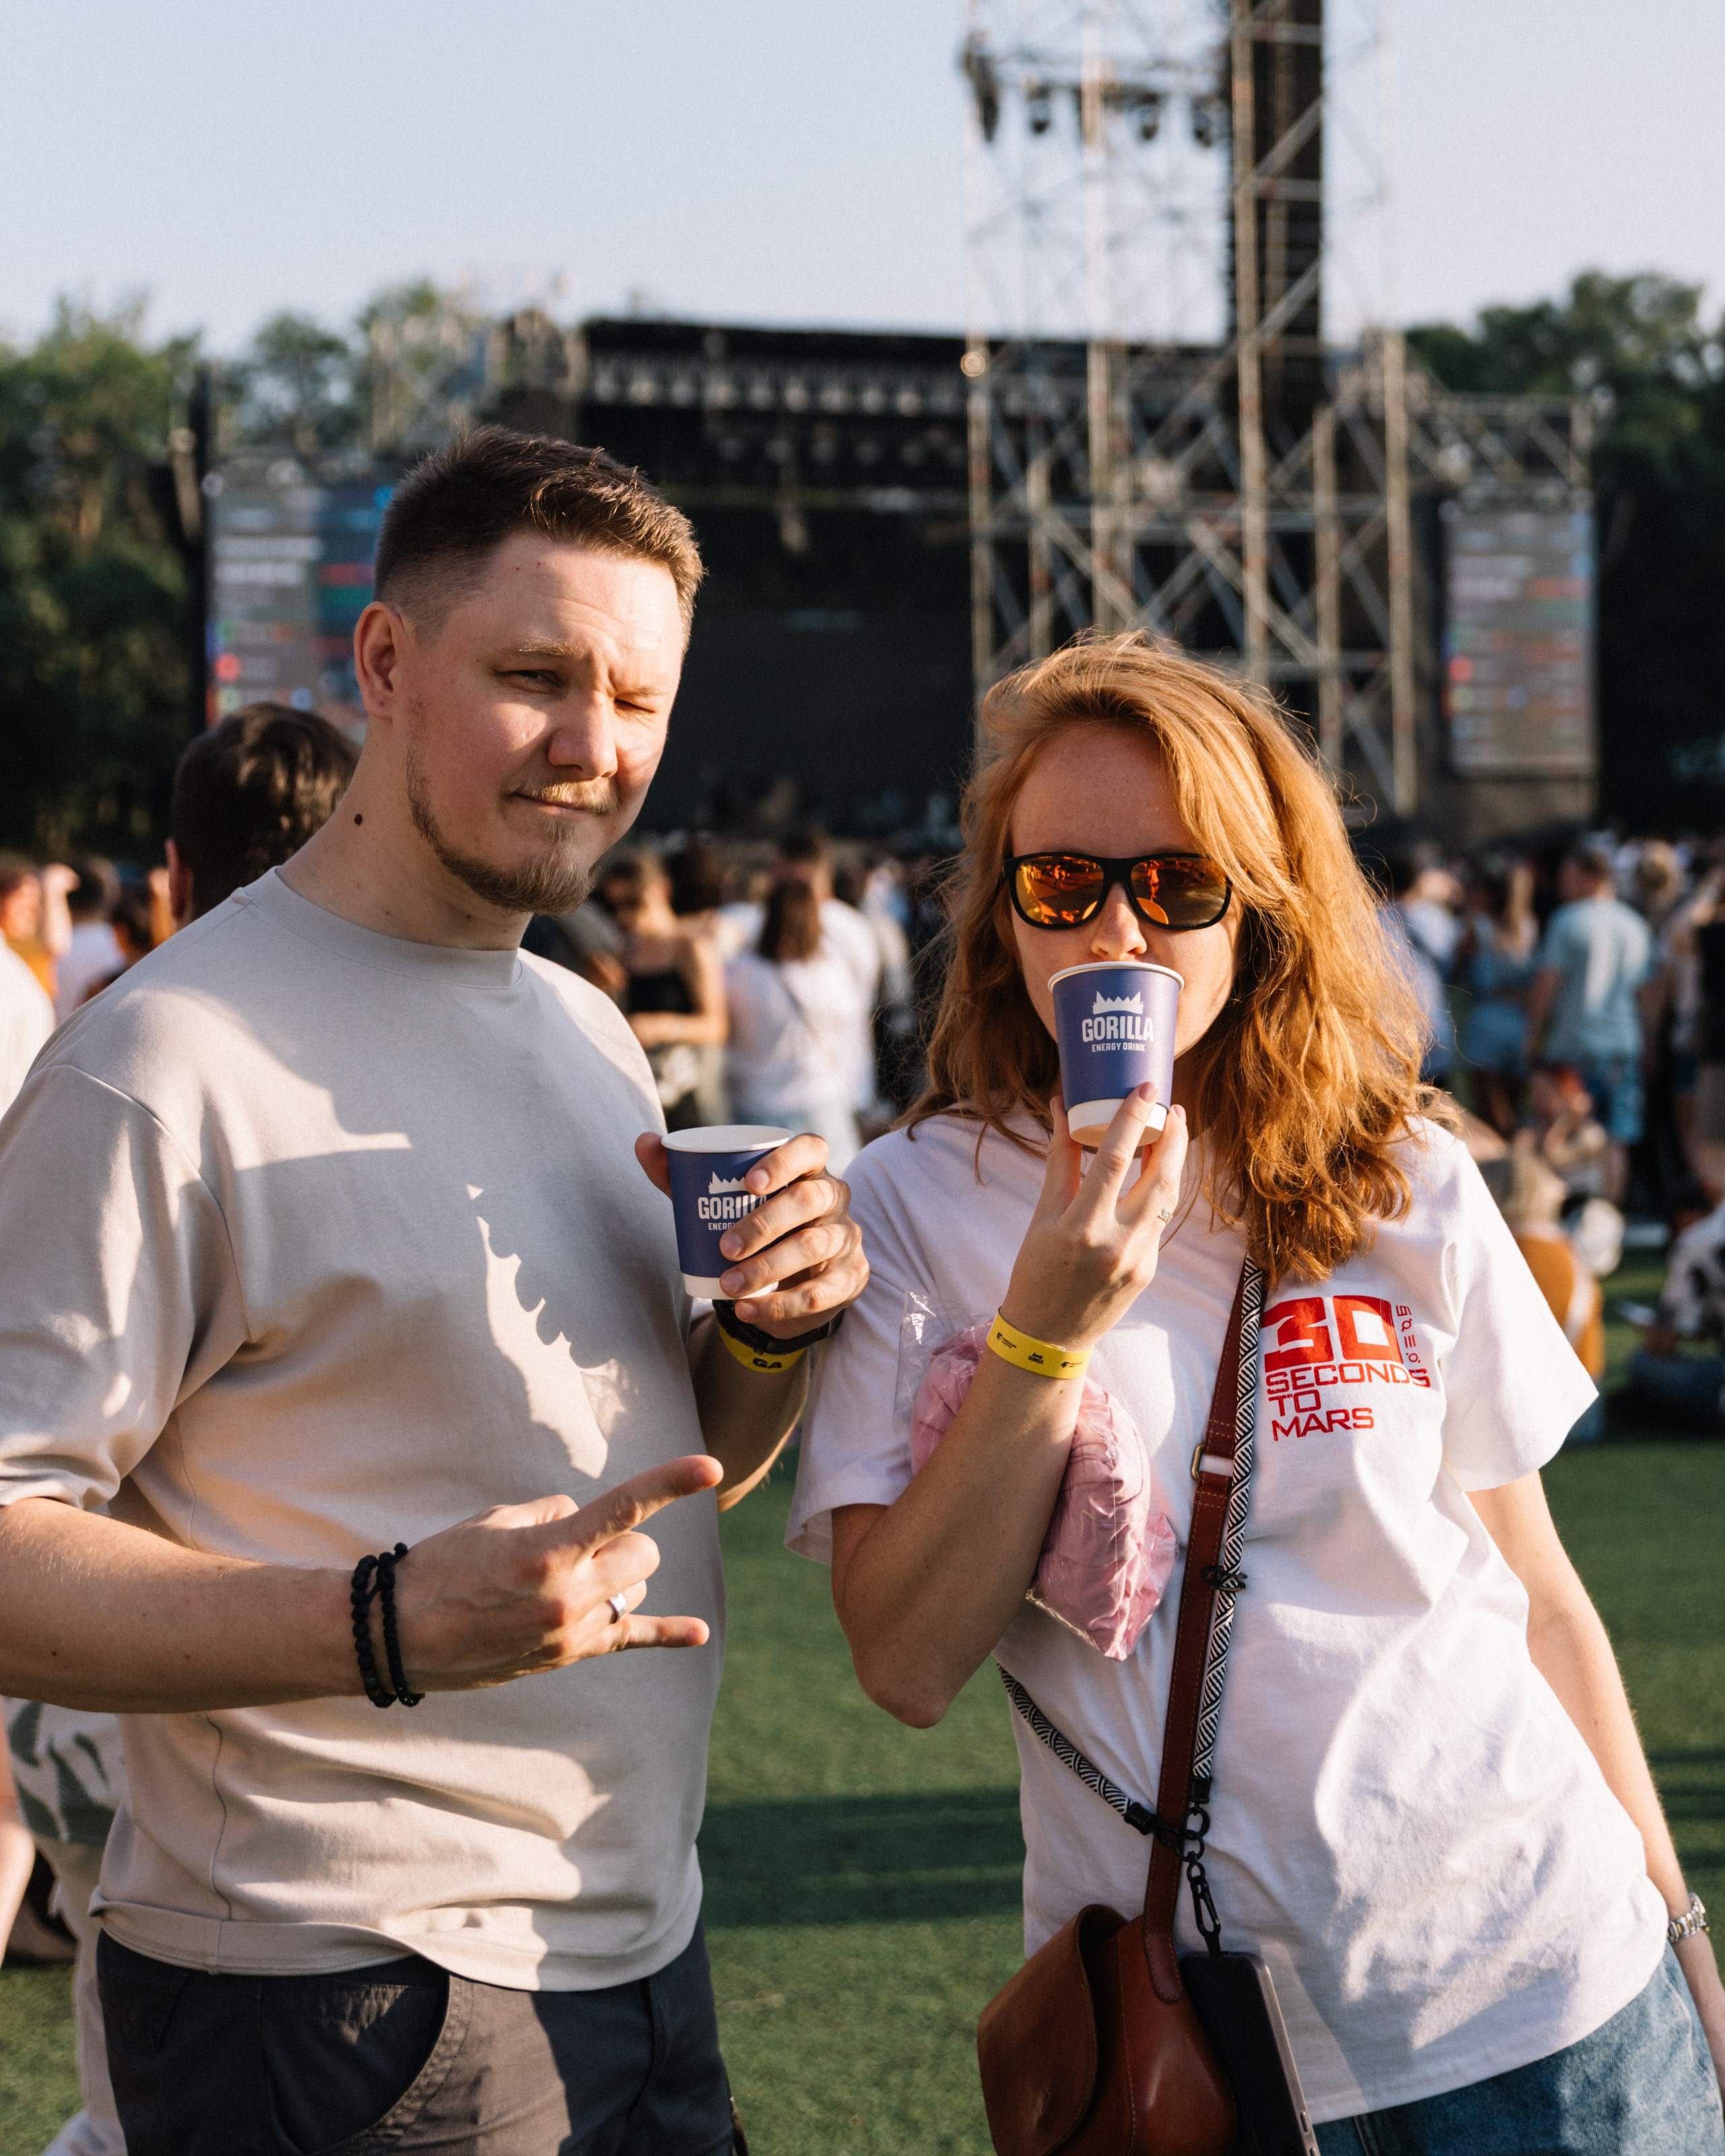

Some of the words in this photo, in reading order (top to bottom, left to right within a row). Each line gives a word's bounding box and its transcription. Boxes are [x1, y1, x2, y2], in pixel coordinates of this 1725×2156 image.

[1081, 1015, 1154, 1042] GORILLA
[1092, 1042, 1121, 1052] ENERGY
[1123, 1042, 1146, 1052] DRINK
[708, 1222, 734, 1230] ENERG
[1261, 1295, 1404, 1372] 30
[753, 1358, 782, 1369] GA
[1028, 1355, 1044, 1364] GORILLA
[1265, 1362, 1431, 1395] SECONDS
[1268, 1389, 1321, 1416] TO
[1272, 1407, 1374, 1441] MARS
